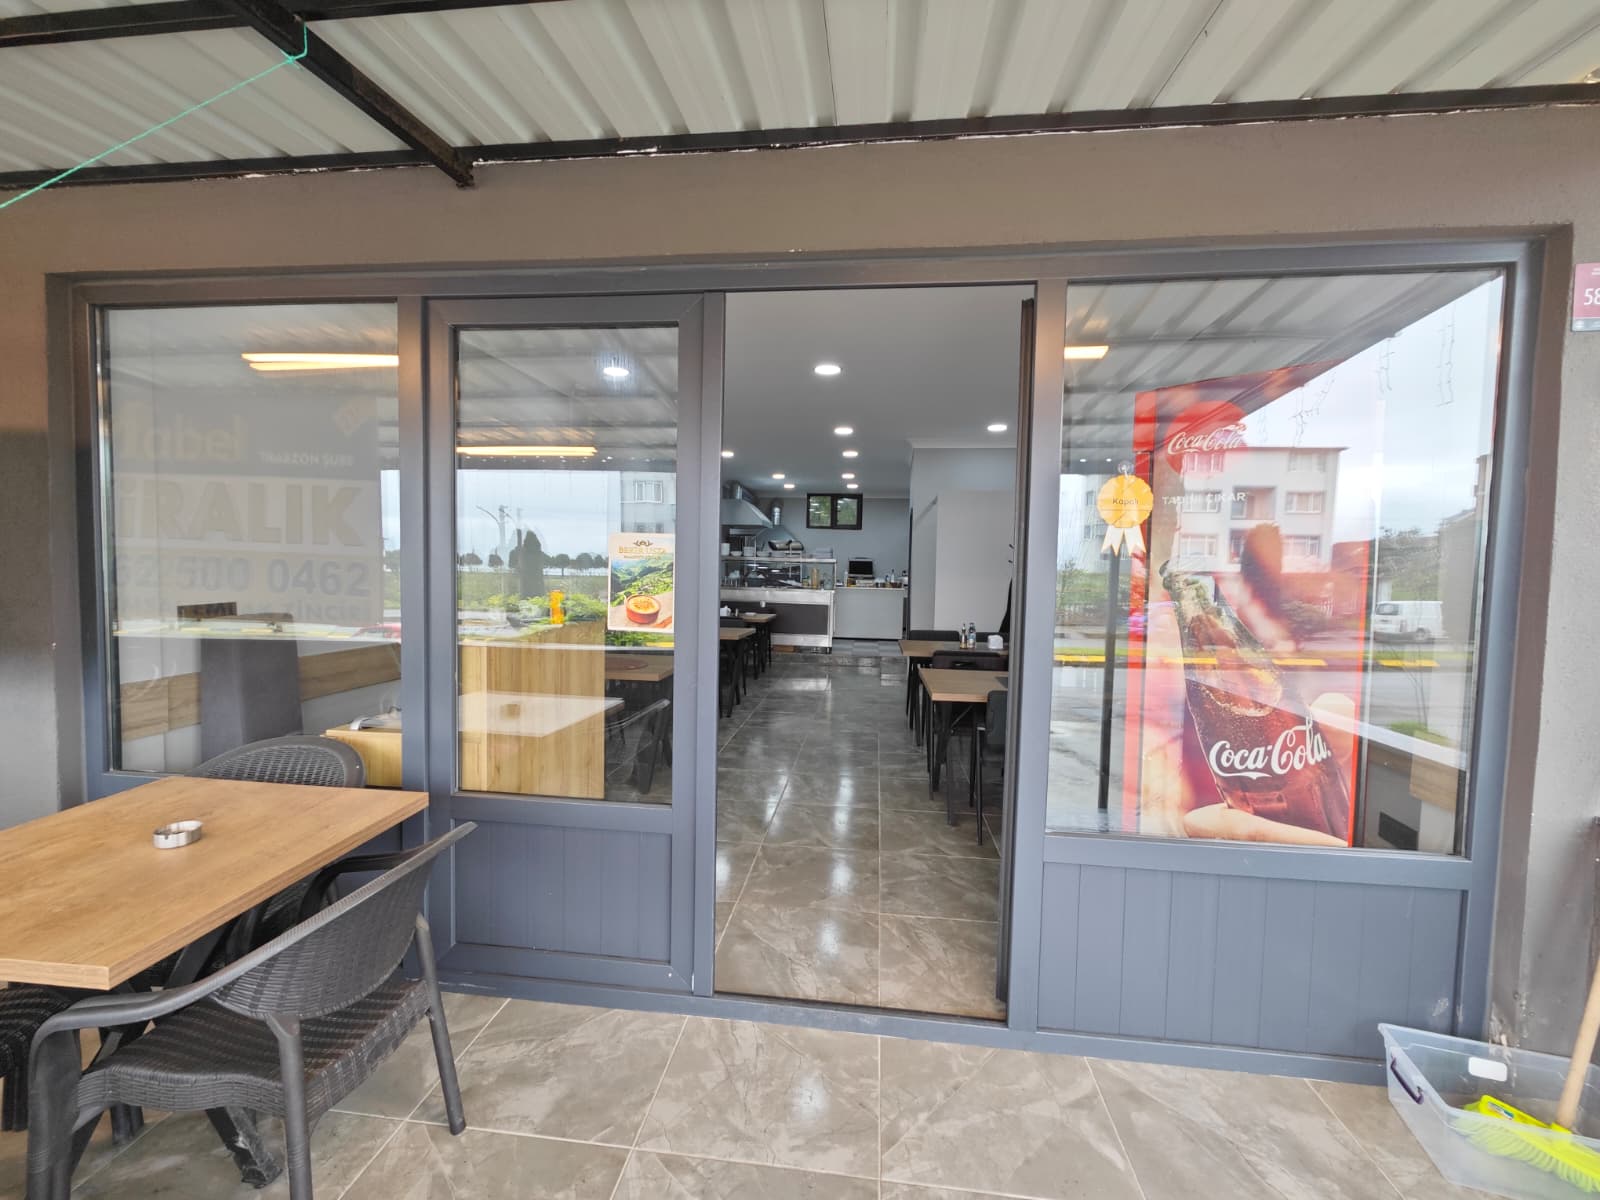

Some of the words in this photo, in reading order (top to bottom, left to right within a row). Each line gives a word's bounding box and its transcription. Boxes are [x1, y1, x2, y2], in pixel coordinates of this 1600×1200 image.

[1167, 422, 1247, 454] Coca-Cola
[267, 559, 372, 598] 0462
[1209, 713, 1332, 780] Coca-Cola
